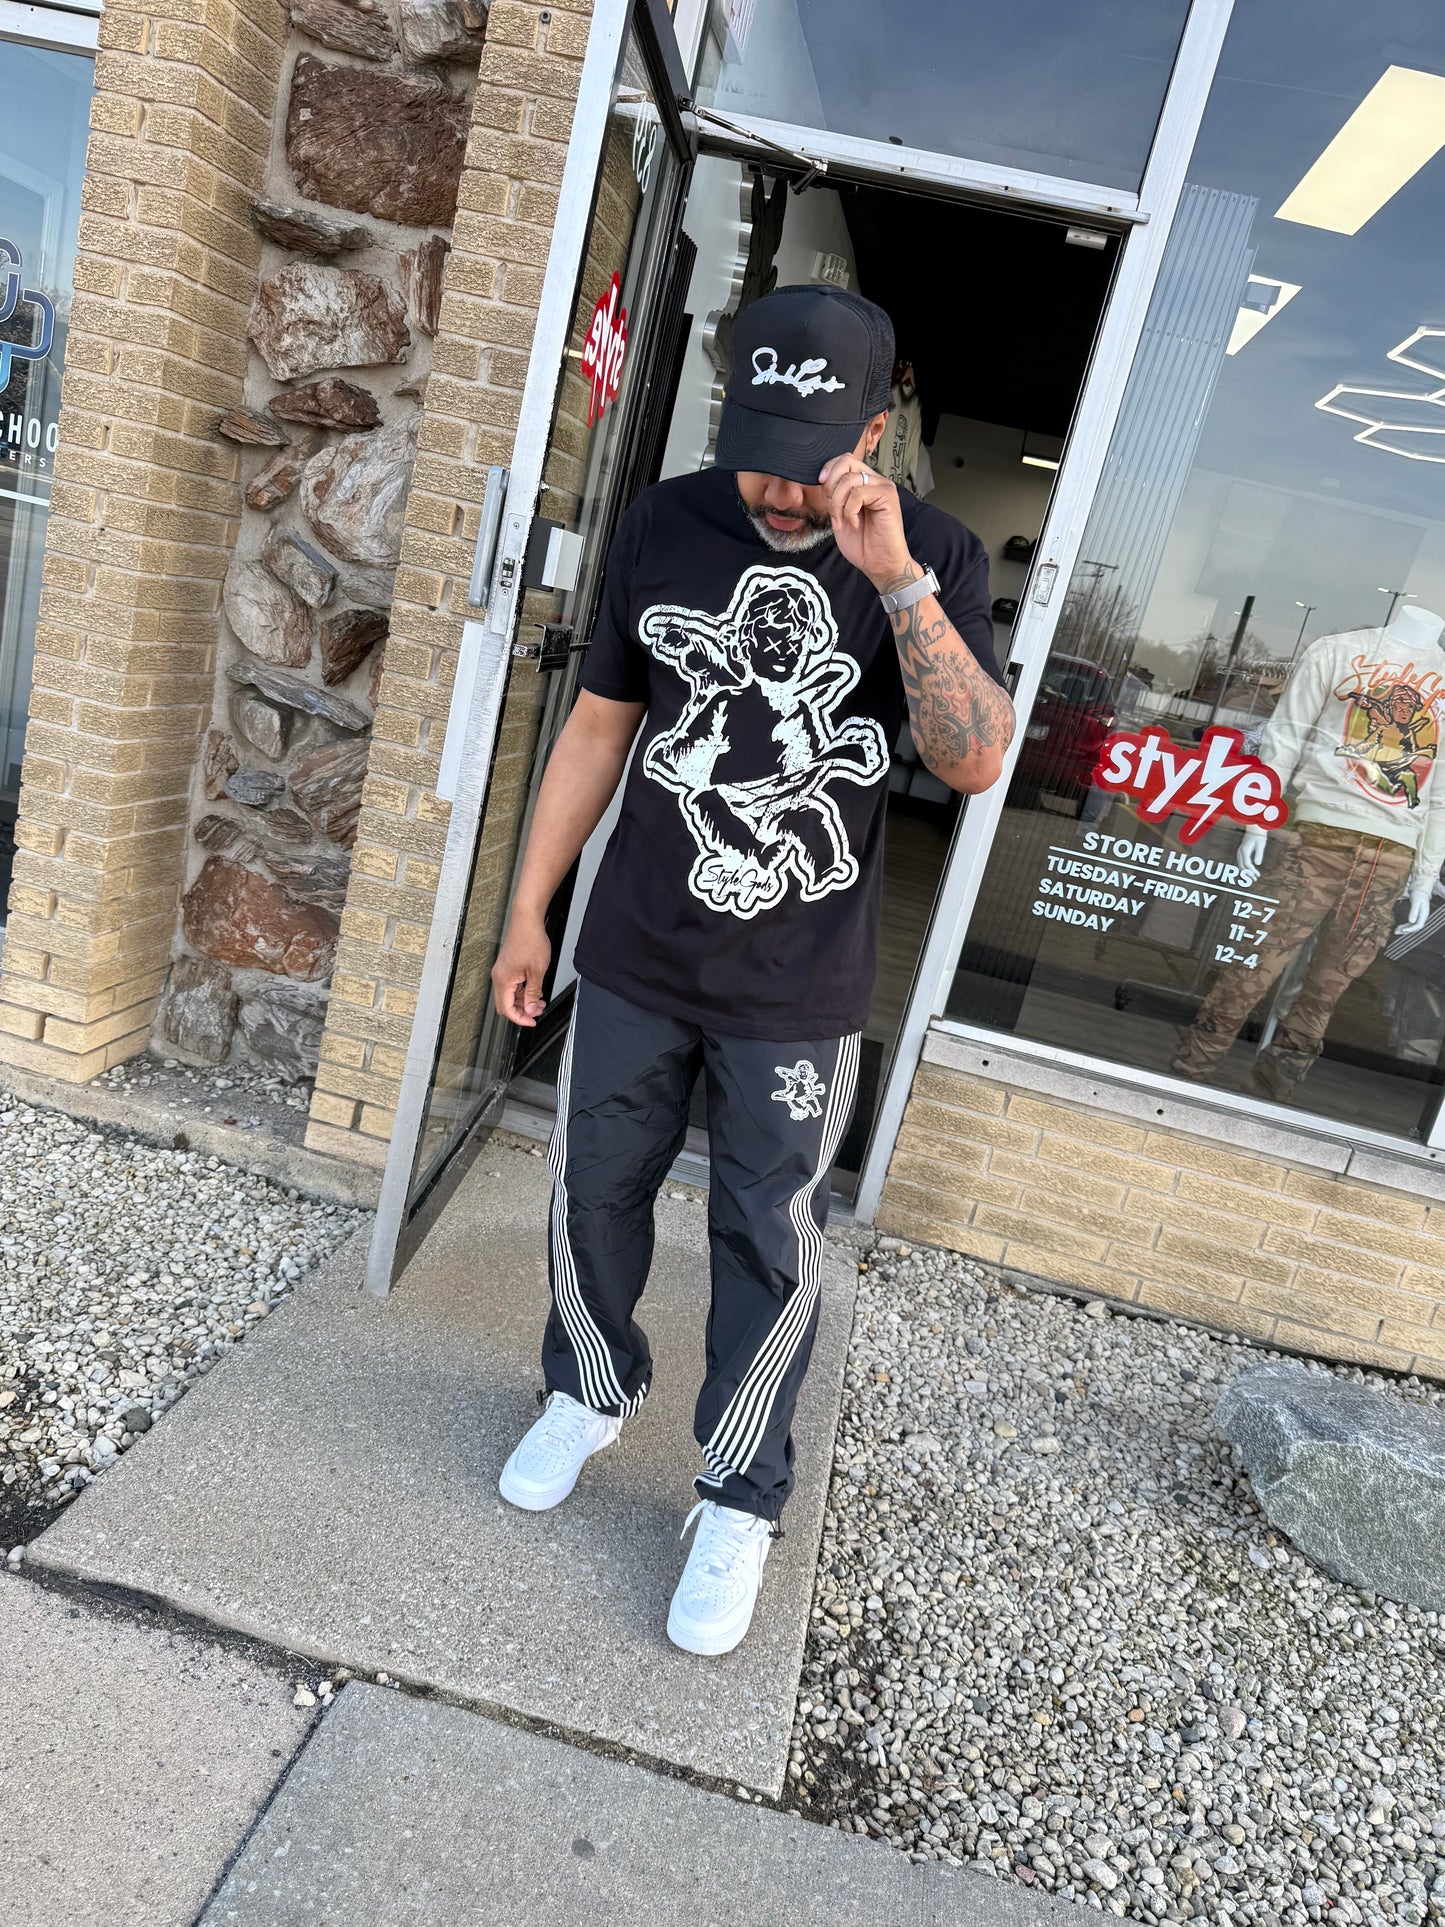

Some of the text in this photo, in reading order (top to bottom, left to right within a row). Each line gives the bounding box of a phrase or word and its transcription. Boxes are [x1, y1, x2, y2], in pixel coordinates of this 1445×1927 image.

[0, 411, 60, 452] HOO
[1102, 735, 1280, 836] style.
[1047, 854, 1276, 924] TUESDAY-FRIDAY 12-7
[1082, 831, 1256, 888] STORE HOURS
[1031, 900, 1259, 970] SUNDAY 12-4
[1038, 877, 1268, 946] SATURDAY 11-7
